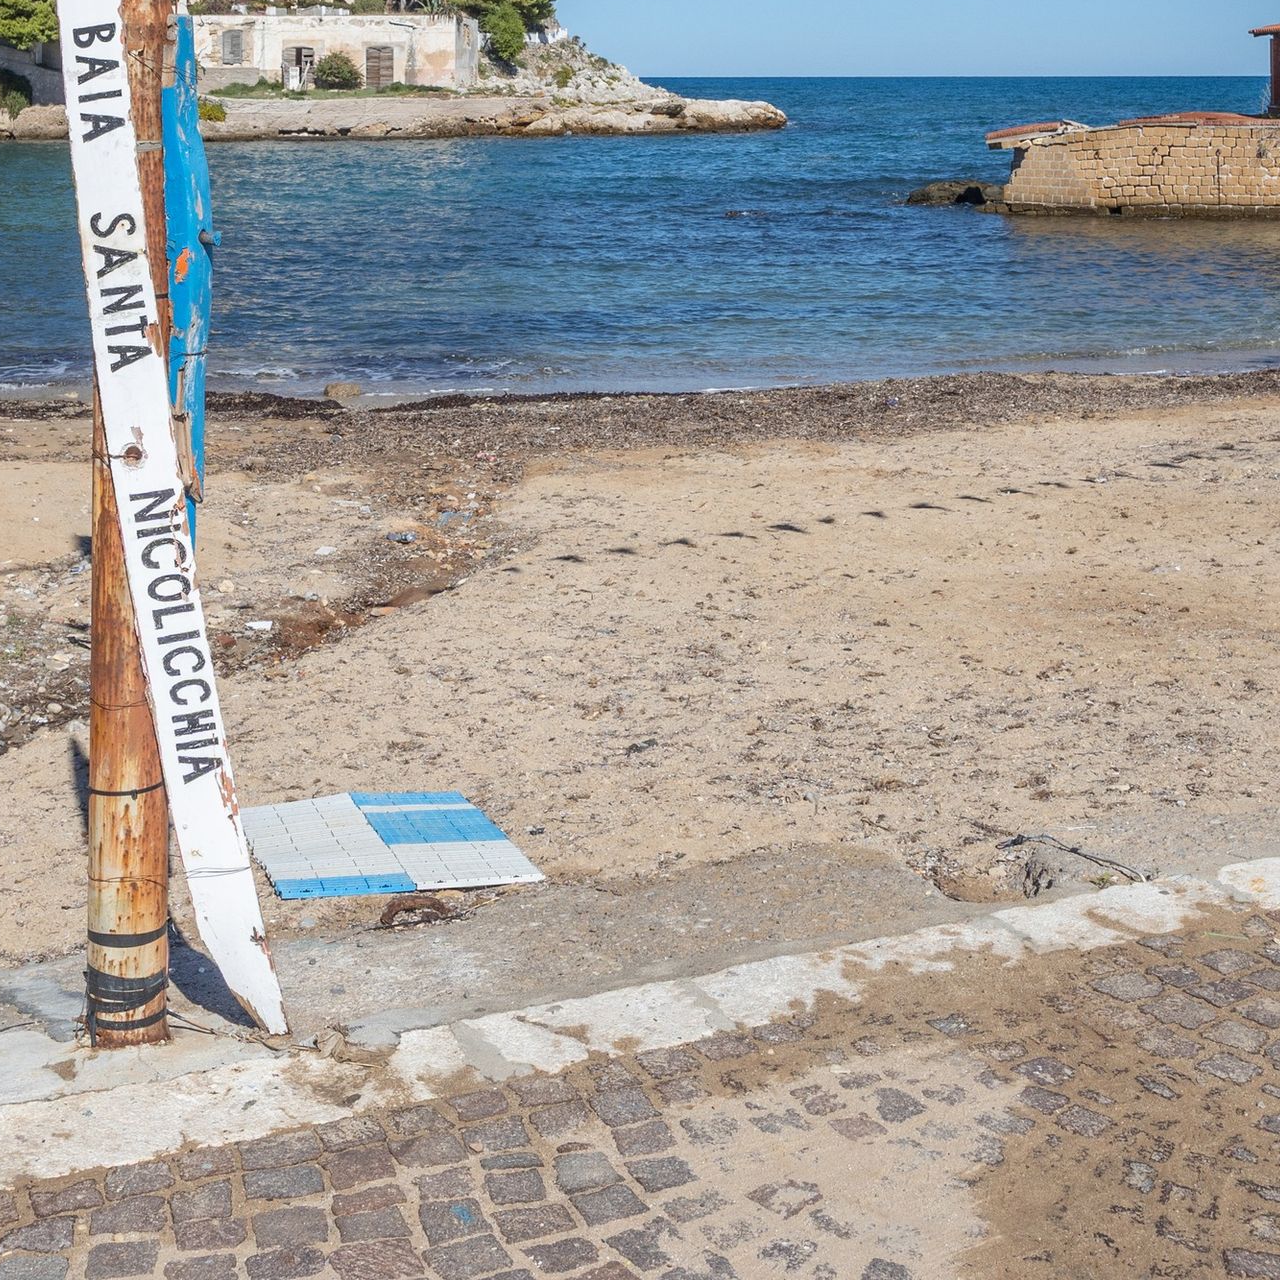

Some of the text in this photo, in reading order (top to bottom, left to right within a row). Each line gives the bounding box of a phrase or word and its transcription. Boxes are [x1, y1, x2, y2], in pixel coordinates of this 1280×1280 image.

[72, 22, 223, 785] BAIA SANTA NICOLICCHIA
